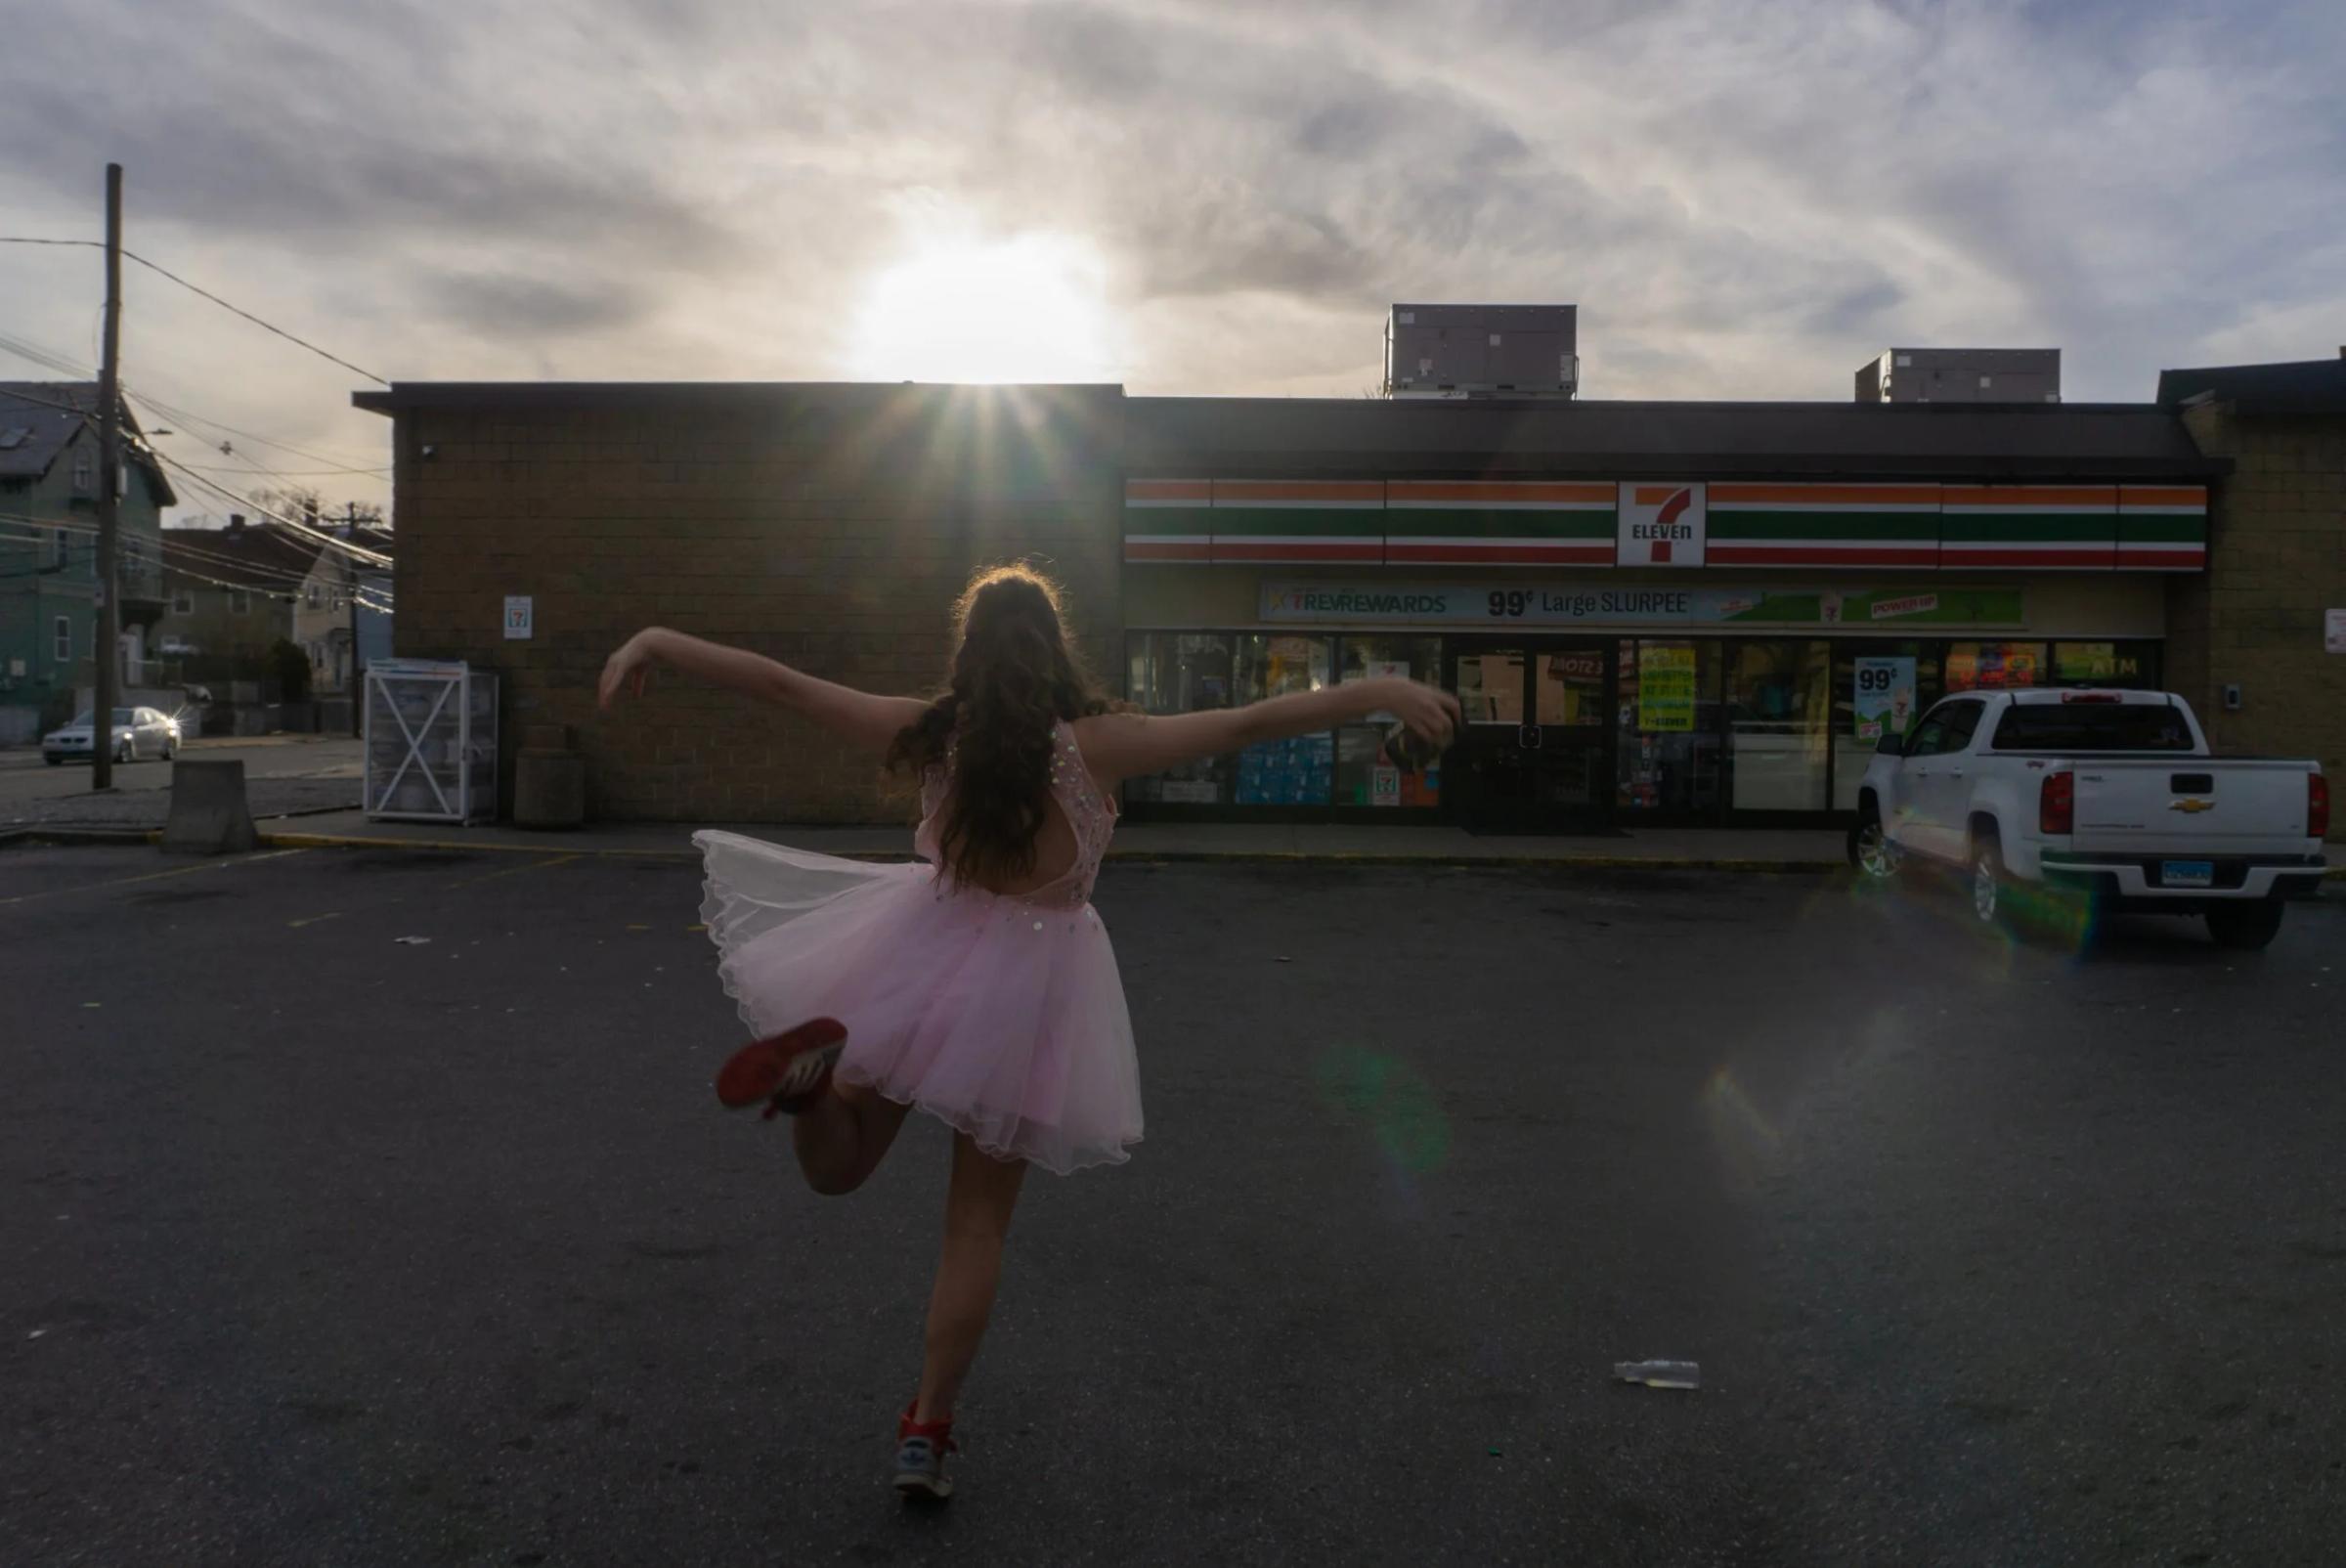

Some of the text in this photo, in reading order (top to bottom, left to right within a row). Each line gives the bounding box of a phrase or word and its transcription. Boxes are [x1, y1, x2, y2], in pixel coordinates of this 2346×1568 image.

[1634, 487, 1691, 563] 7
[1542, 591, 1596, 617] Large
[1600, 591, 1689, 614] SLURPEE
[2091, 657, 2139, 675] ATM
